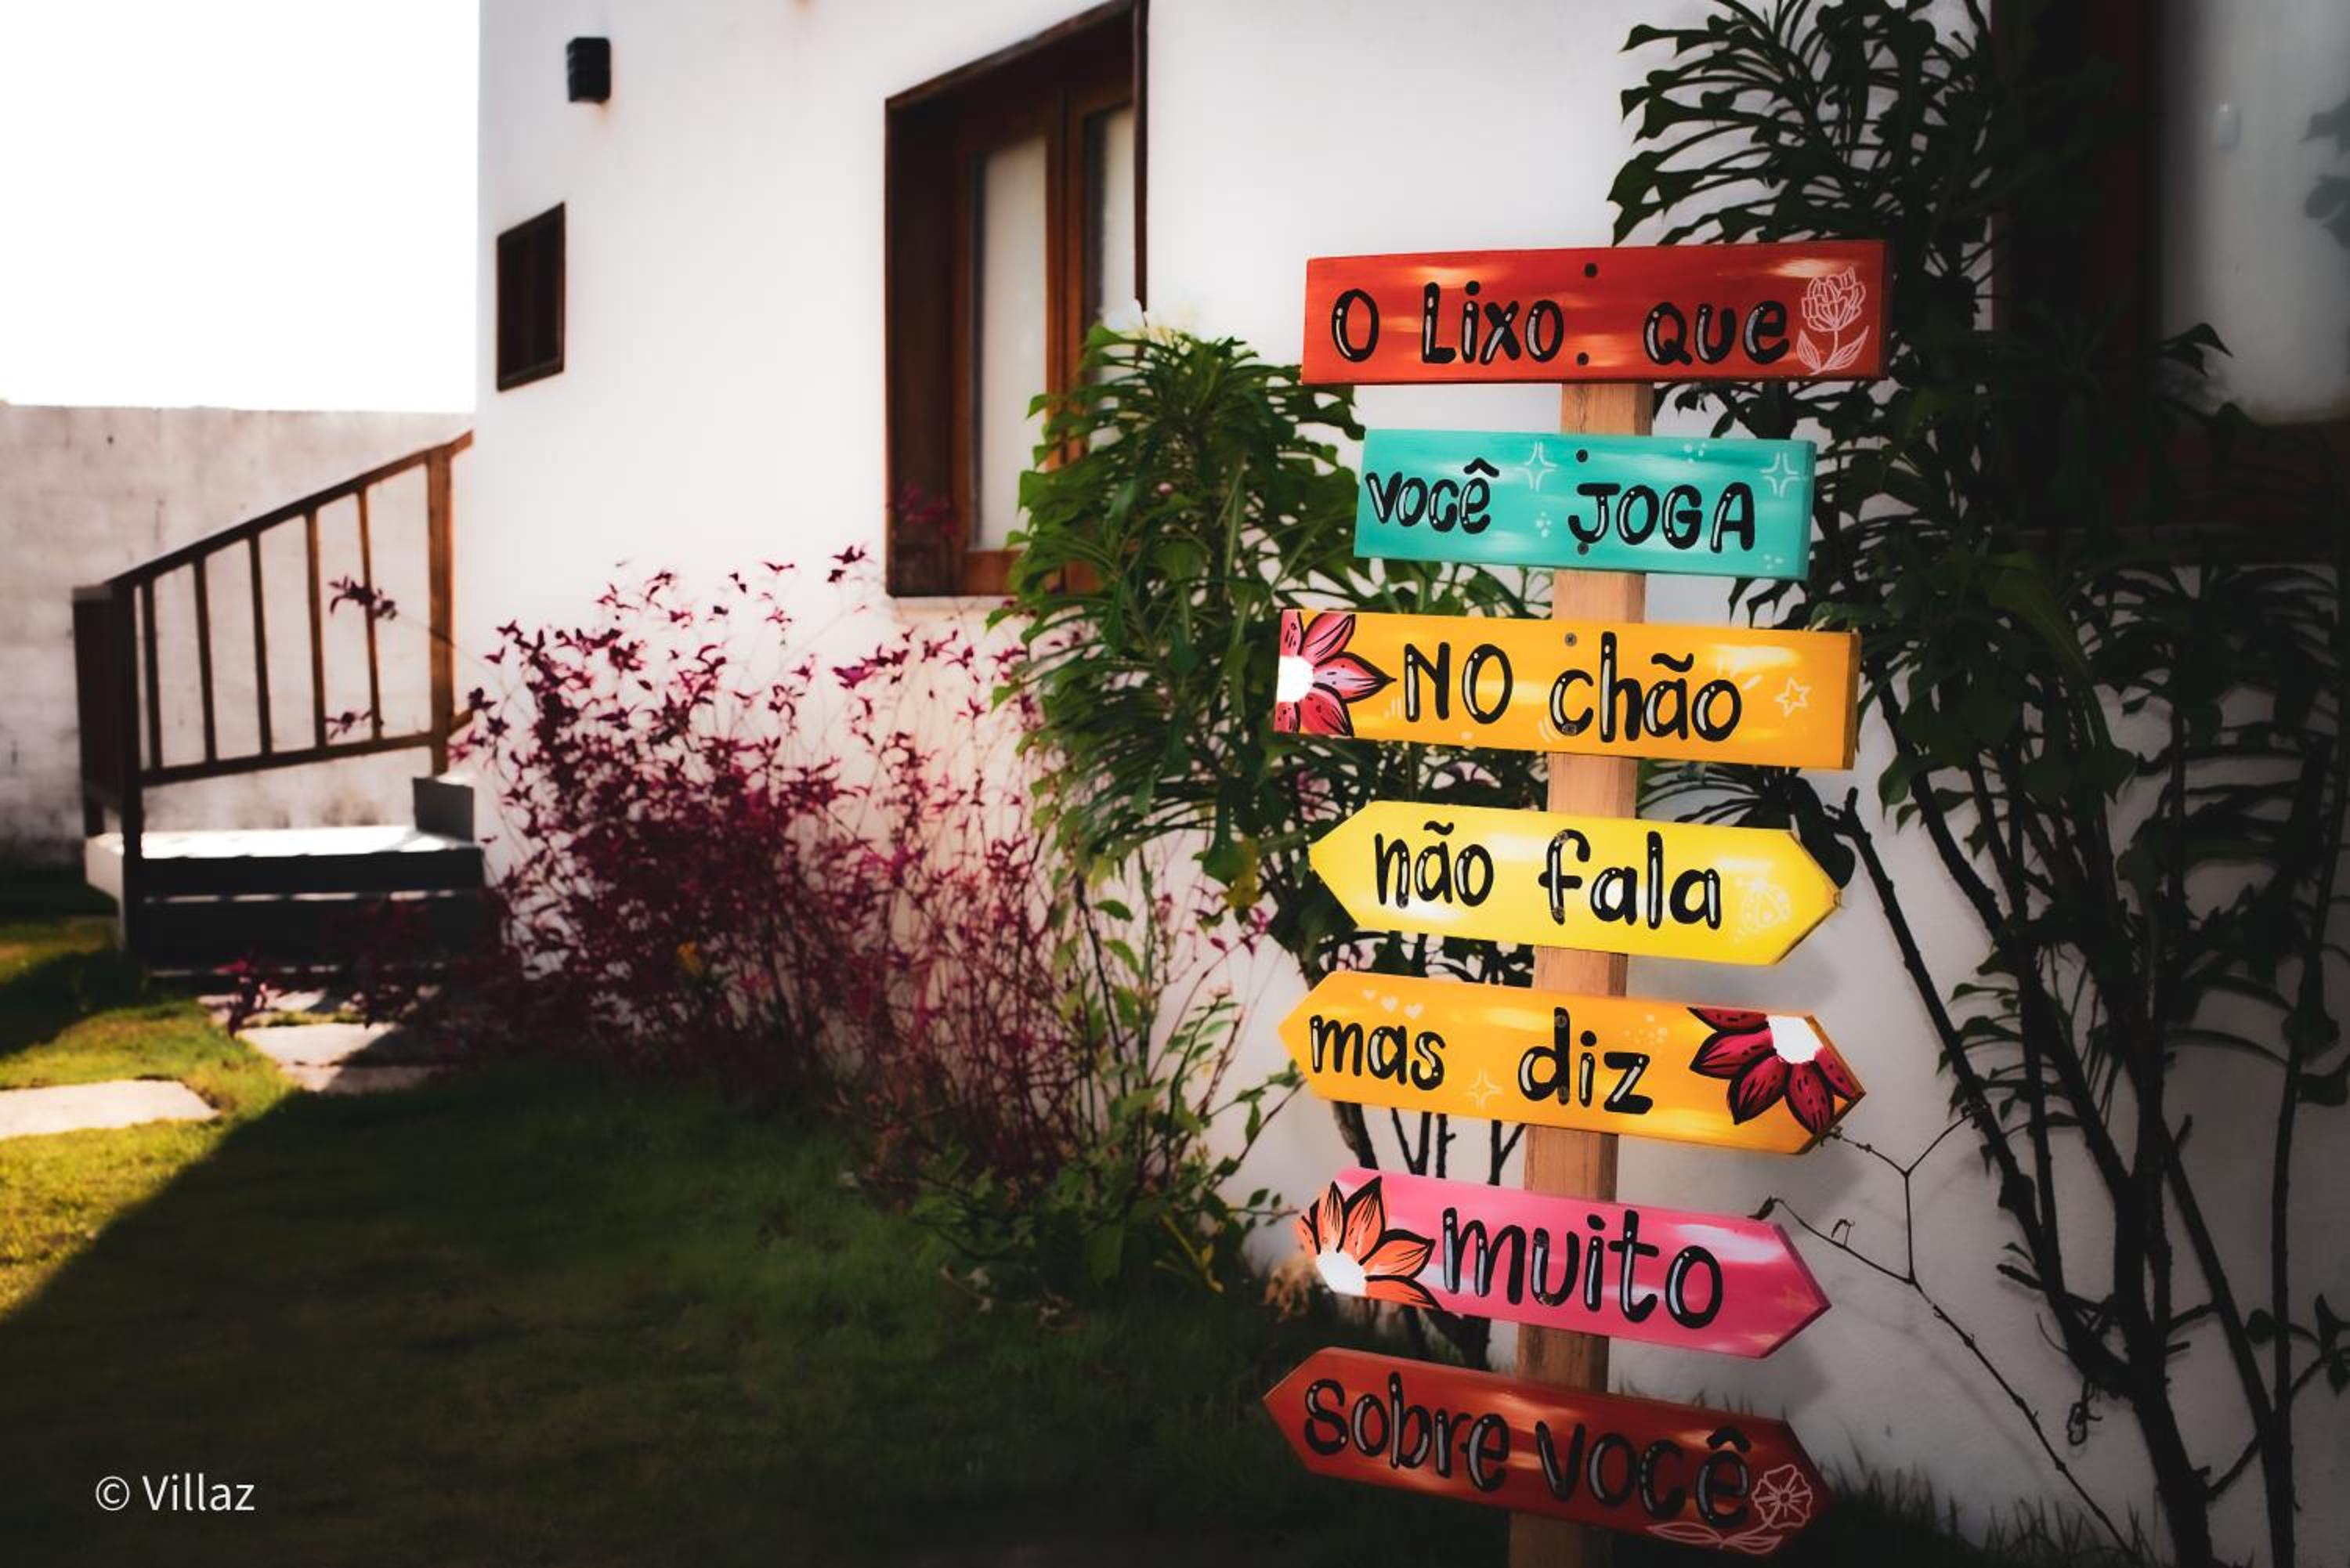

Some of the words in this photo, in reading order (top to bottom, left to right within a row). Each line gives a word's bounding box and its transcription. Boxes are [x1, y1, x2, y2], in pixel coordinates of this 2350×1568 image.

[1331, 287, 1379, 363] O
[1421, 280, 1564, 365] Lixo
[1568, 481, 1756, 553] JOGA
[1403, 641, 1513, 724] NO
[1549, 630, 1743, 743] chão
[1374, 820, 1495, 908] não
[1538, 829, 1723, 930] fala
[1309, 1013, 1446, 1090] mas
[1517, 1006, 1654, 1115] diz
[1441, 1206, 1723, 1330] muito
